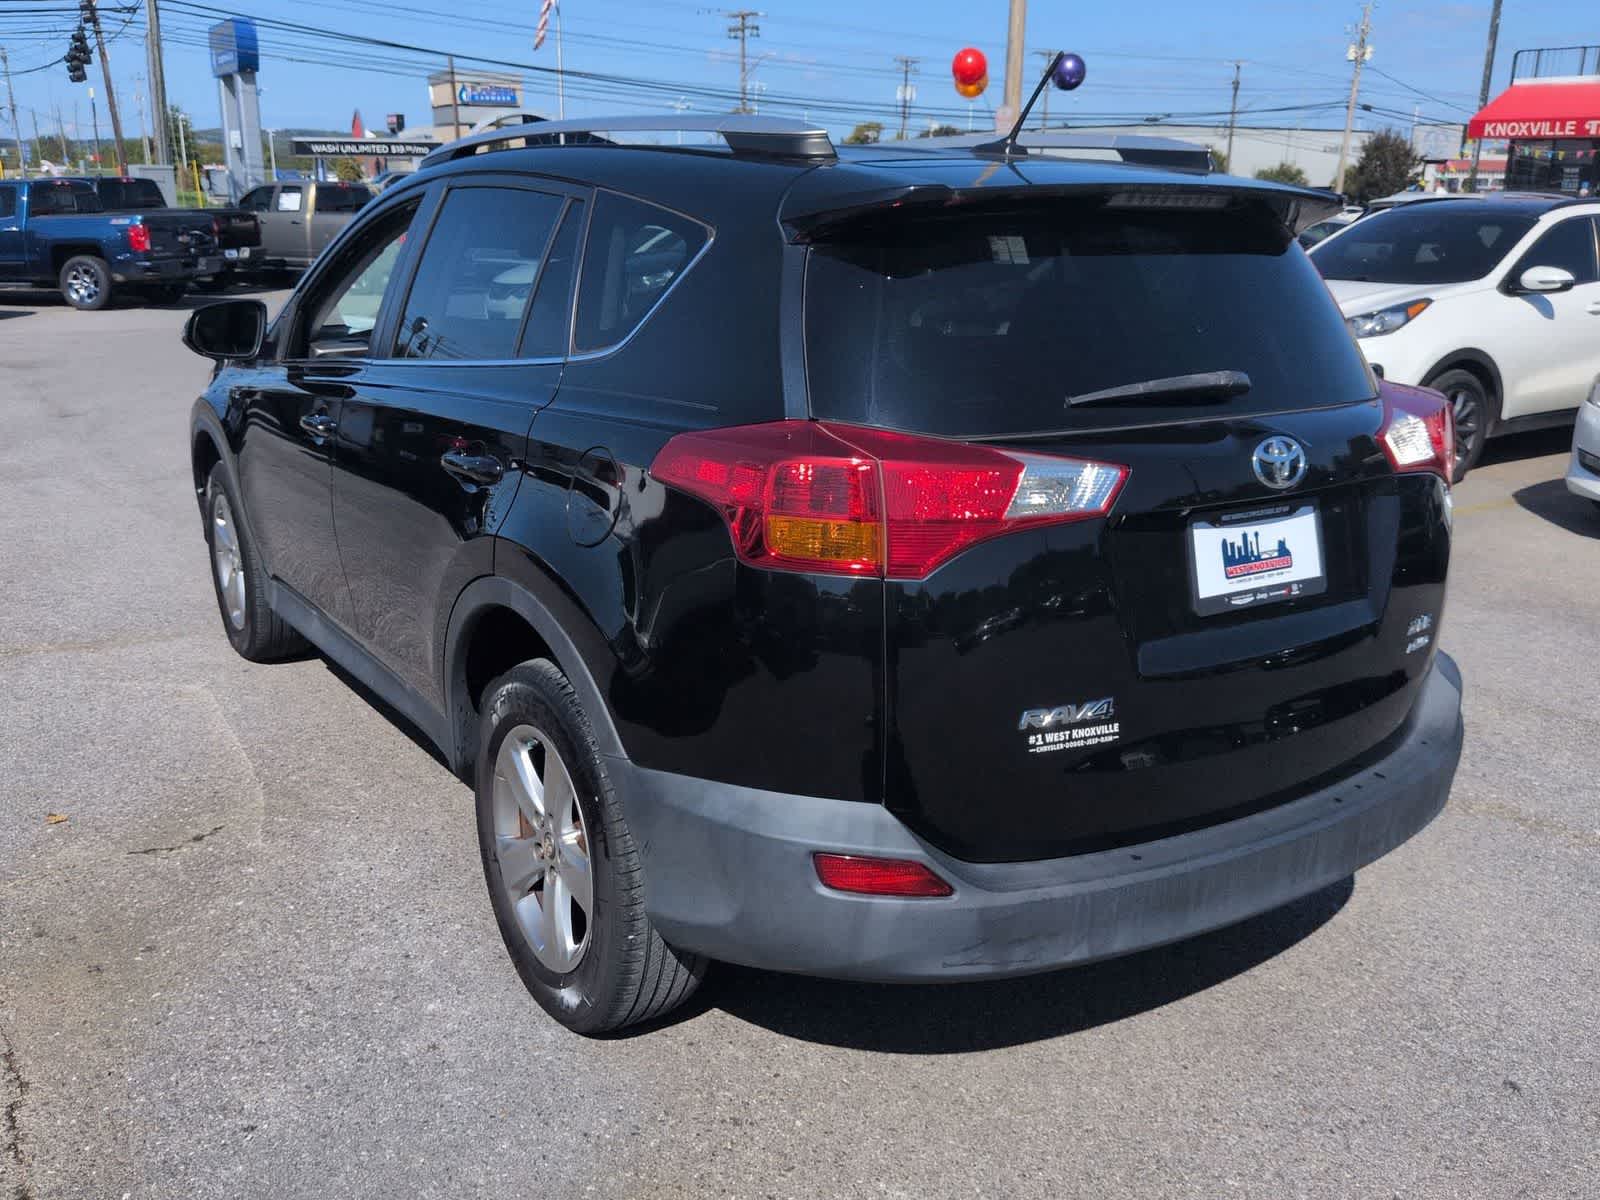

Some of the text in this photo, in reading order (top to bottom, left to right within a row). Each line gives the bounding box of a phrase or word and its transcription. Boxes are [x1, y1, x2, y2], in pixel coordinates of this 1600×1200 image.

[1484, 121, 1577, 137] KNOXVILLE
[311, 143, 339, 154] WASH
[341, 143, 389, 154] UNLIMITED
[1018, 697, 1114, 730] RAV4
[1028, 722, 1120, 746] #1 WEST KNOXVILLE
